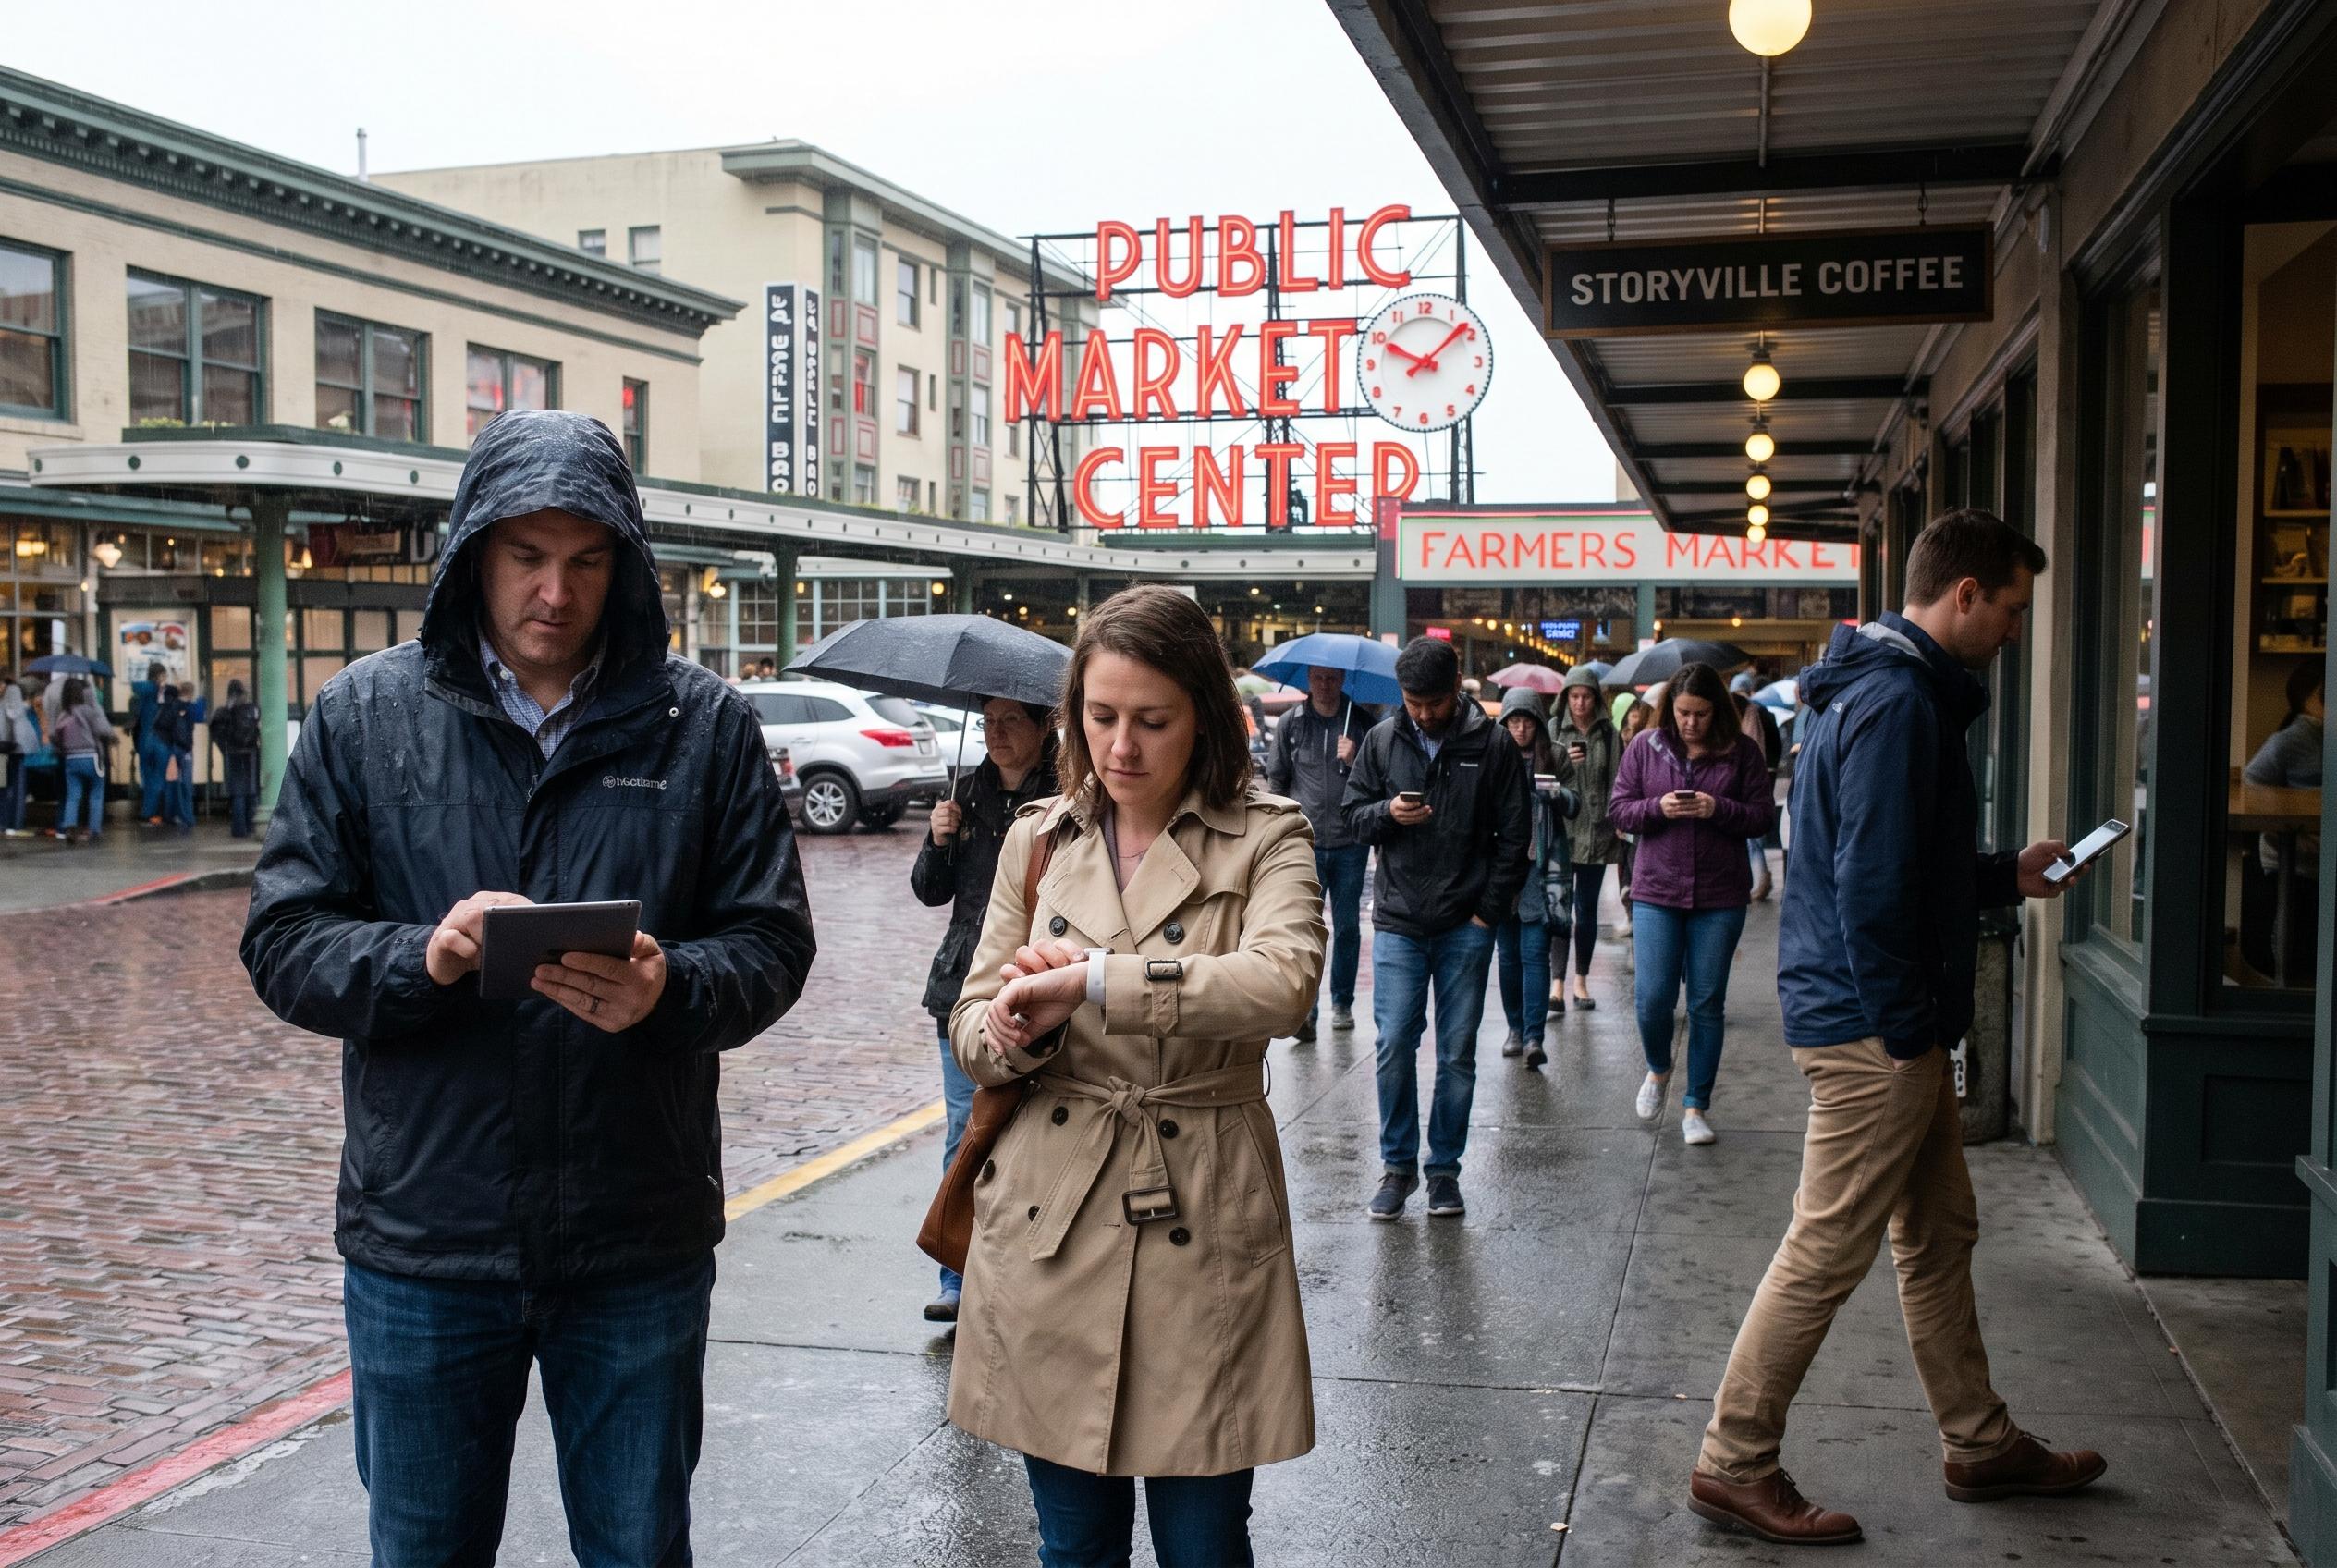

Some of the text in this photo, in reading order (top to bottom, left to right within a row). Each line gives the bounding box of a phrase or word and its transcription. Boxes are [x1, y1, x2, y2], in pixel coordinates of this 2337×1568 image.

[1096, 204, 1411, 301] PUBLIC
[1571, 256, 1964, 306] STORYVILLE COFFEE
[1418, 301, 1433, 315] 12
[1392, 310, 1403, 324] 11
[1371, 332, 1387, 345] 10
[1466, 328, 1476, 341] 2
[1005, 318, 1357, 423] MARKET
[1365, 358, 1377, 372] 9
[1372, 386, 1382, 399] 8
[1465, 384, 1475, 396] 4
[1393, 406, 1402, 419] 7
[1446, 404, 1456, 418] 5
[1419, 412, 1429, 425] 6
[1421, 531, 1637, 570] FARMERS
